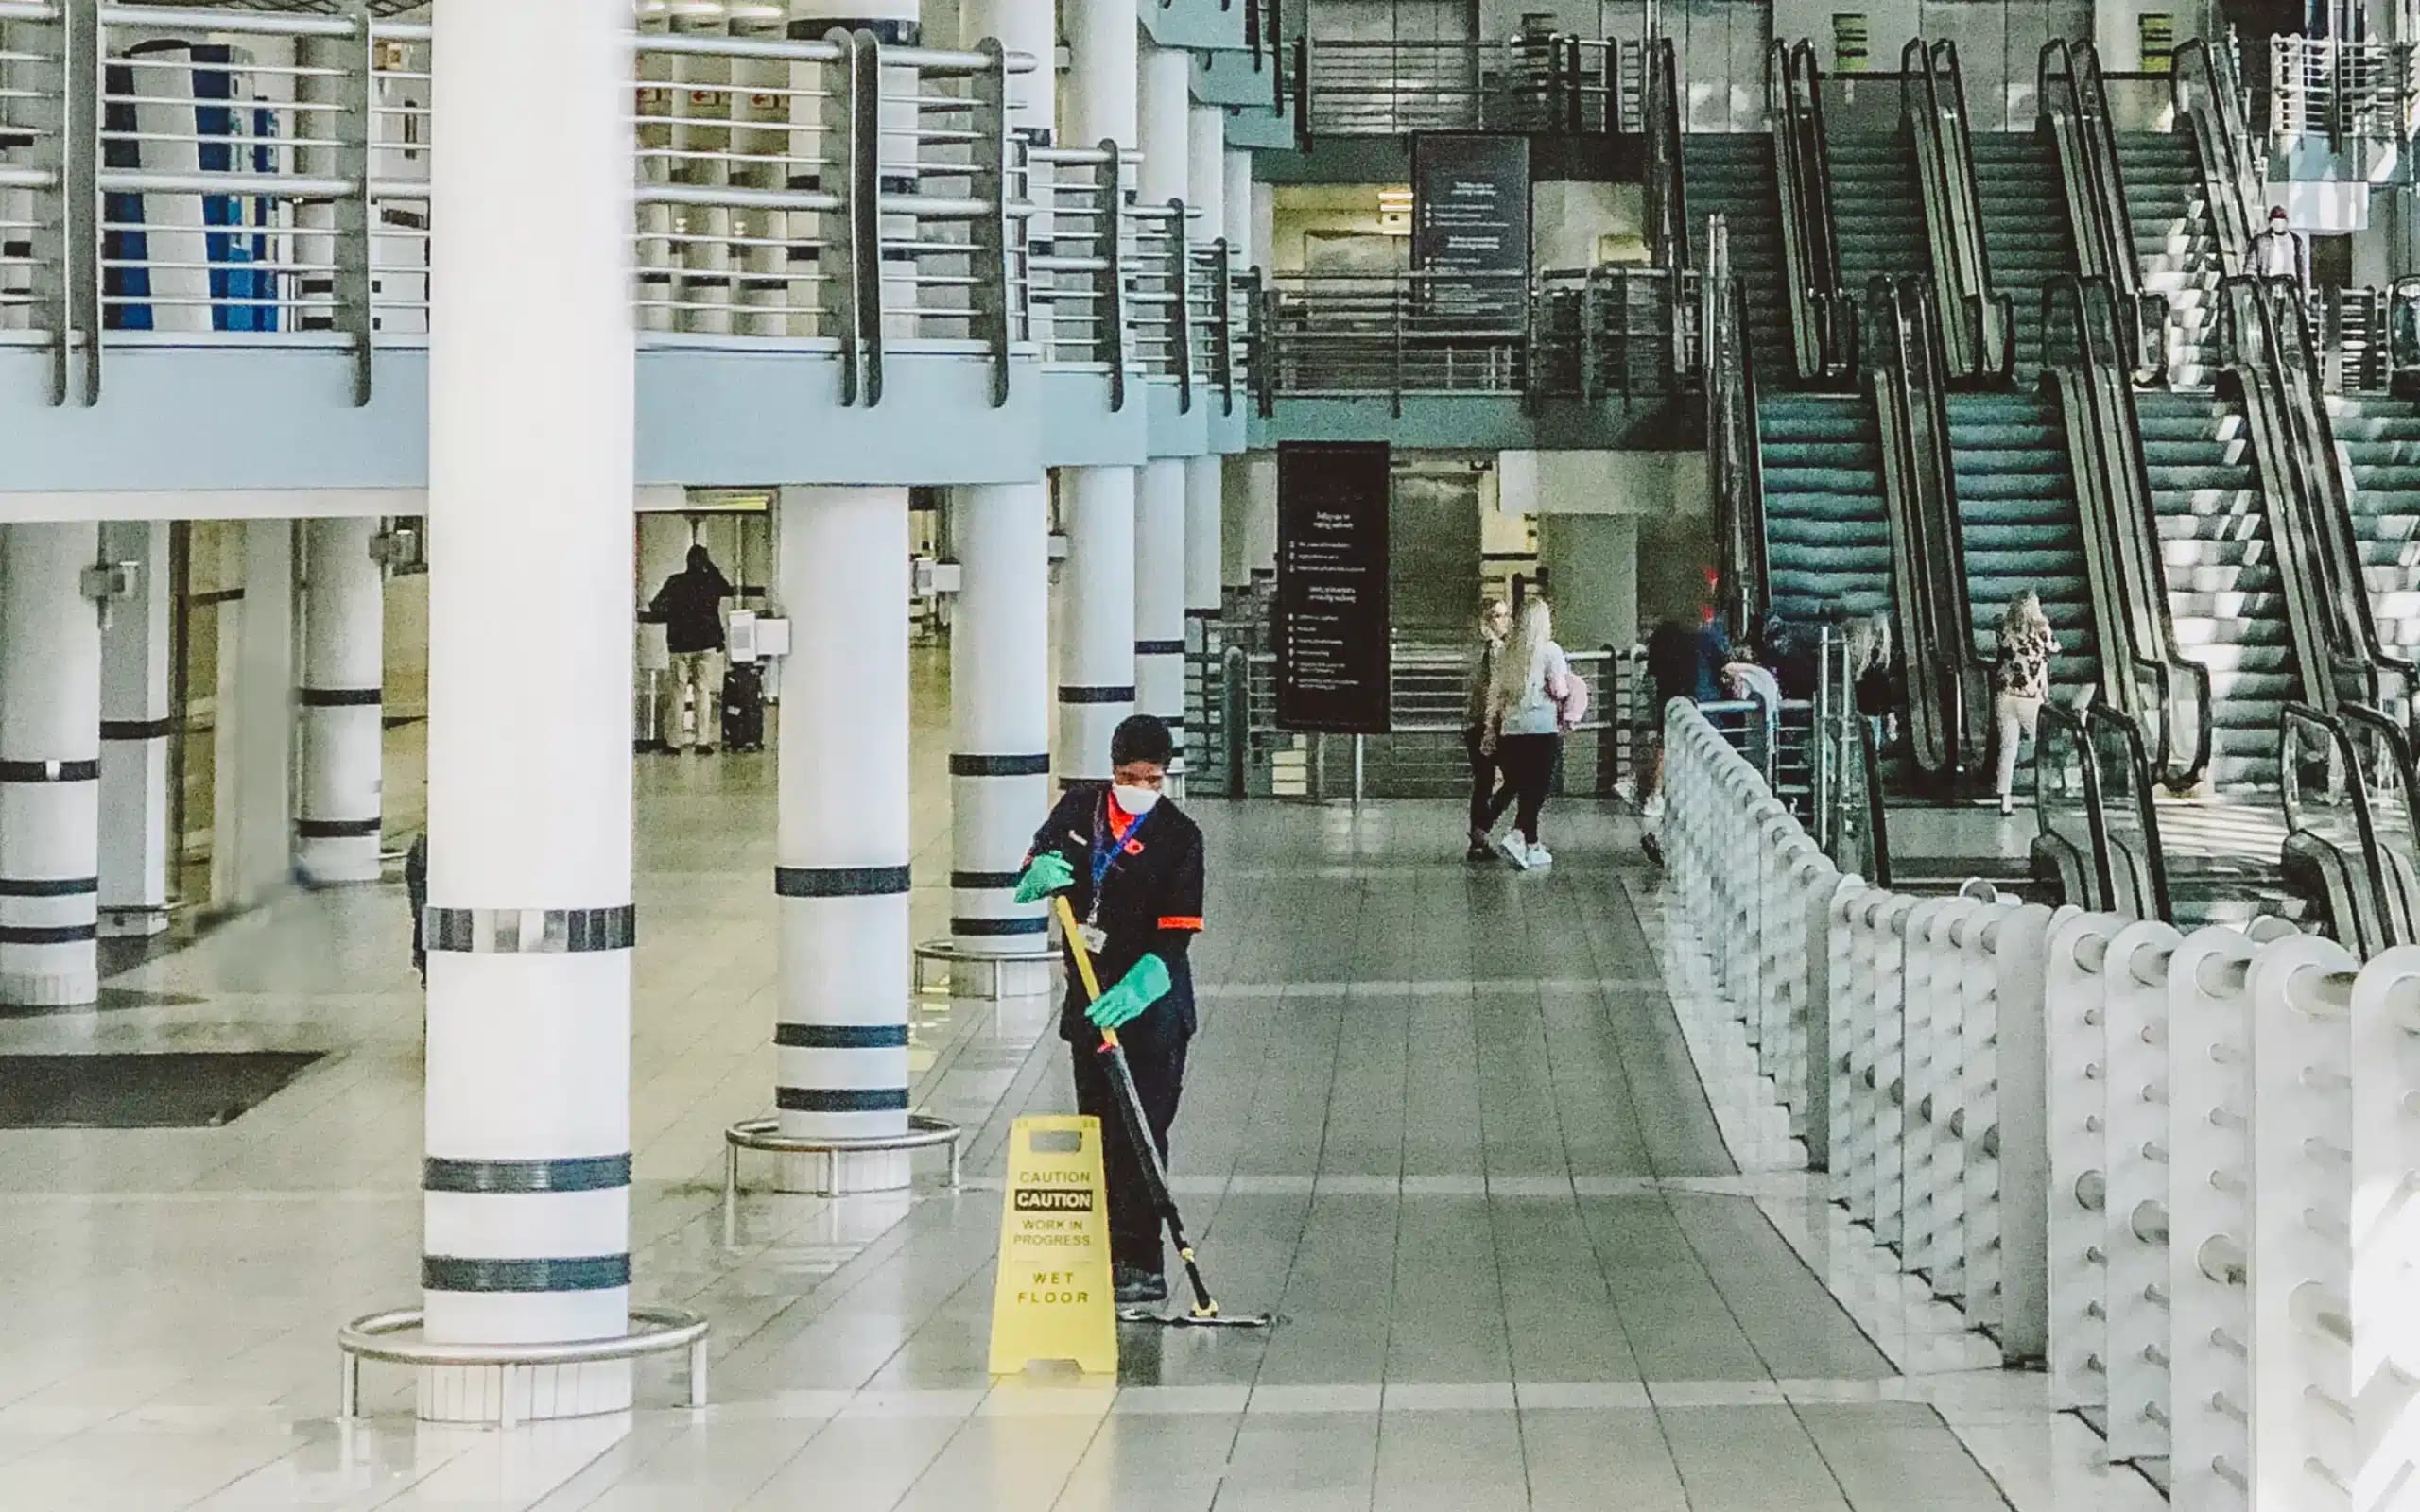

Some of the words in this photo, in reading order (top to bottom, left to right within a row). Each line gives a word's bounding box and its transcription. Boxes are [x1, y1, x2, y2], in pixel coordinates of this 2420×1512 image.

[1019, 1171, 1091, 1183] CAUTION
[1016, 1192, 1091, 1209] CAUTION
[1022, 1219, 1064, 1230] WORK
[1069, 1220, 1083, 1230] IN
[1012, 1234, 1091, 1246] PROGRESS
[1032, 1272, 1074, 1285] WET
[1017, 1291, 1089, 1304] FLOOR
